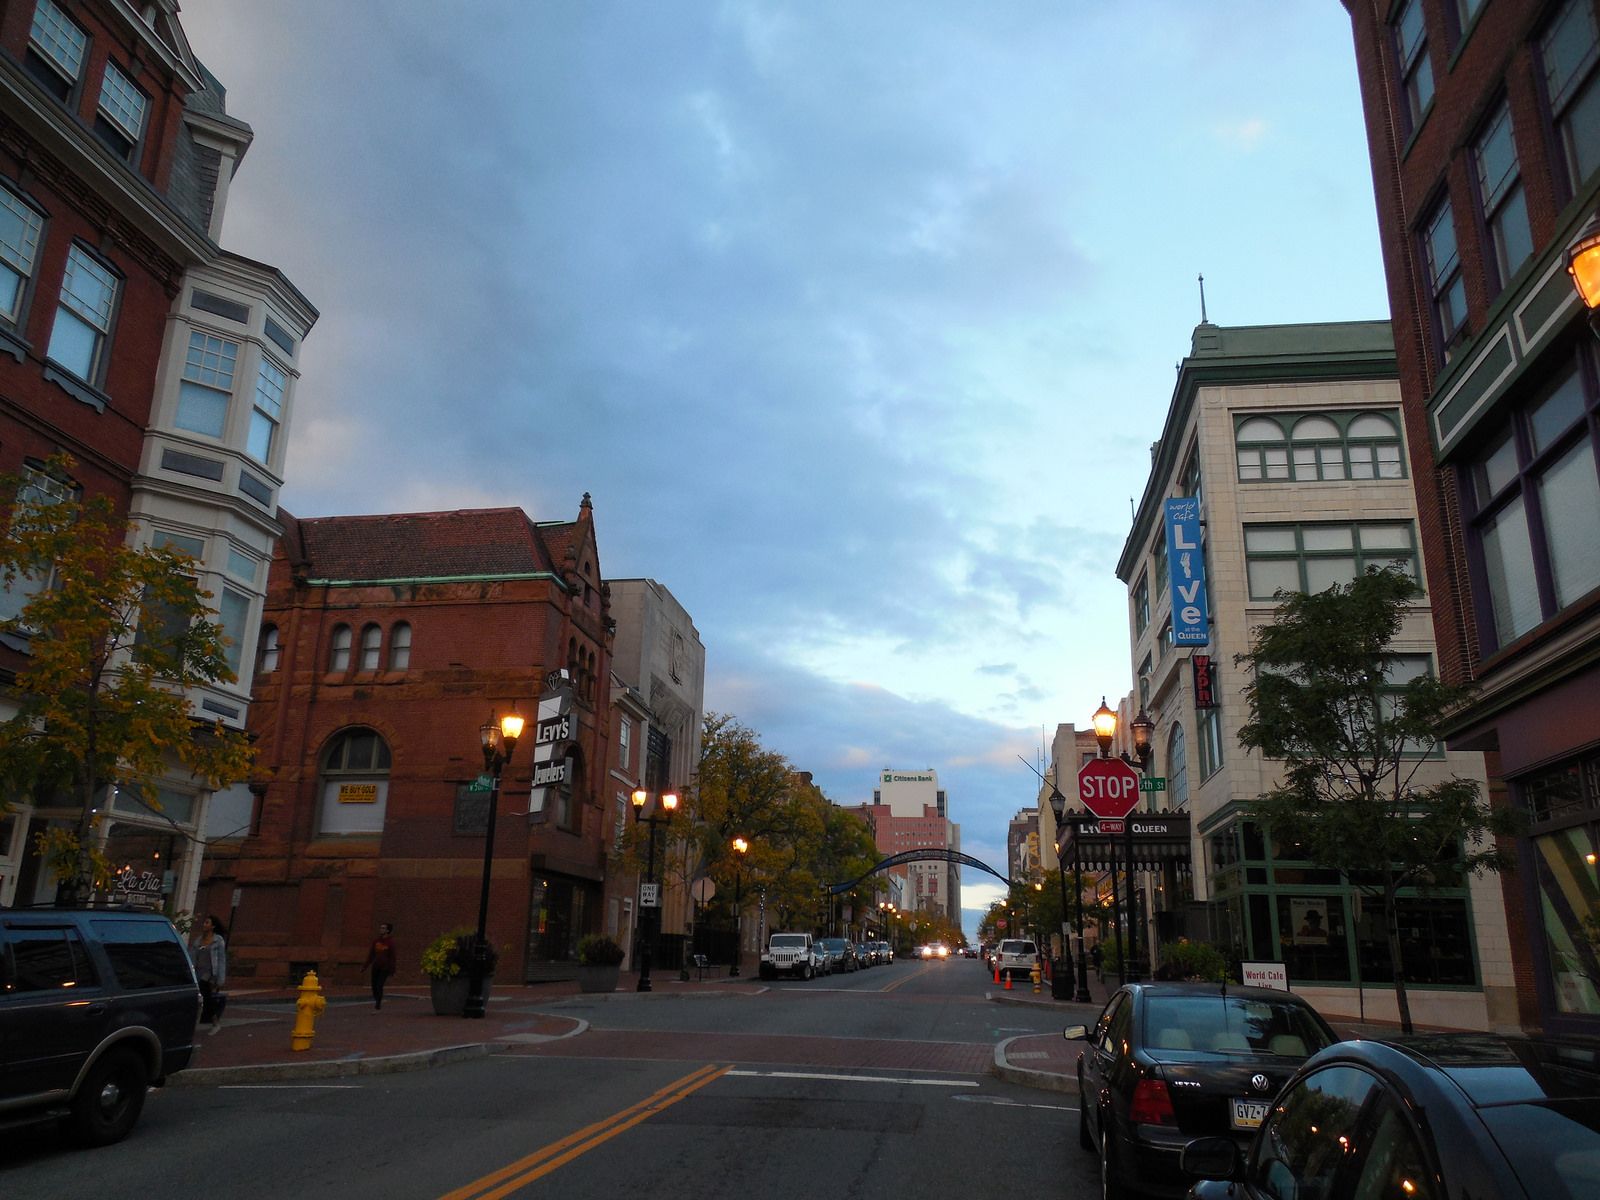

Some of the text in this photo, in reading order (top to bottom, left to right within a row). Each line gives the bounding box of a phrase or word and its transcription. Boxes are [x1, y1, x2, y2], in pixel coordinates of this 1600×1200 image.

[1082, 775, 1135, 798] STOP
[1157, 781, 1164, 789] St
[1101, 823, 1122, 832] 4-WAY
[1246, 970, 1265, 980] World
